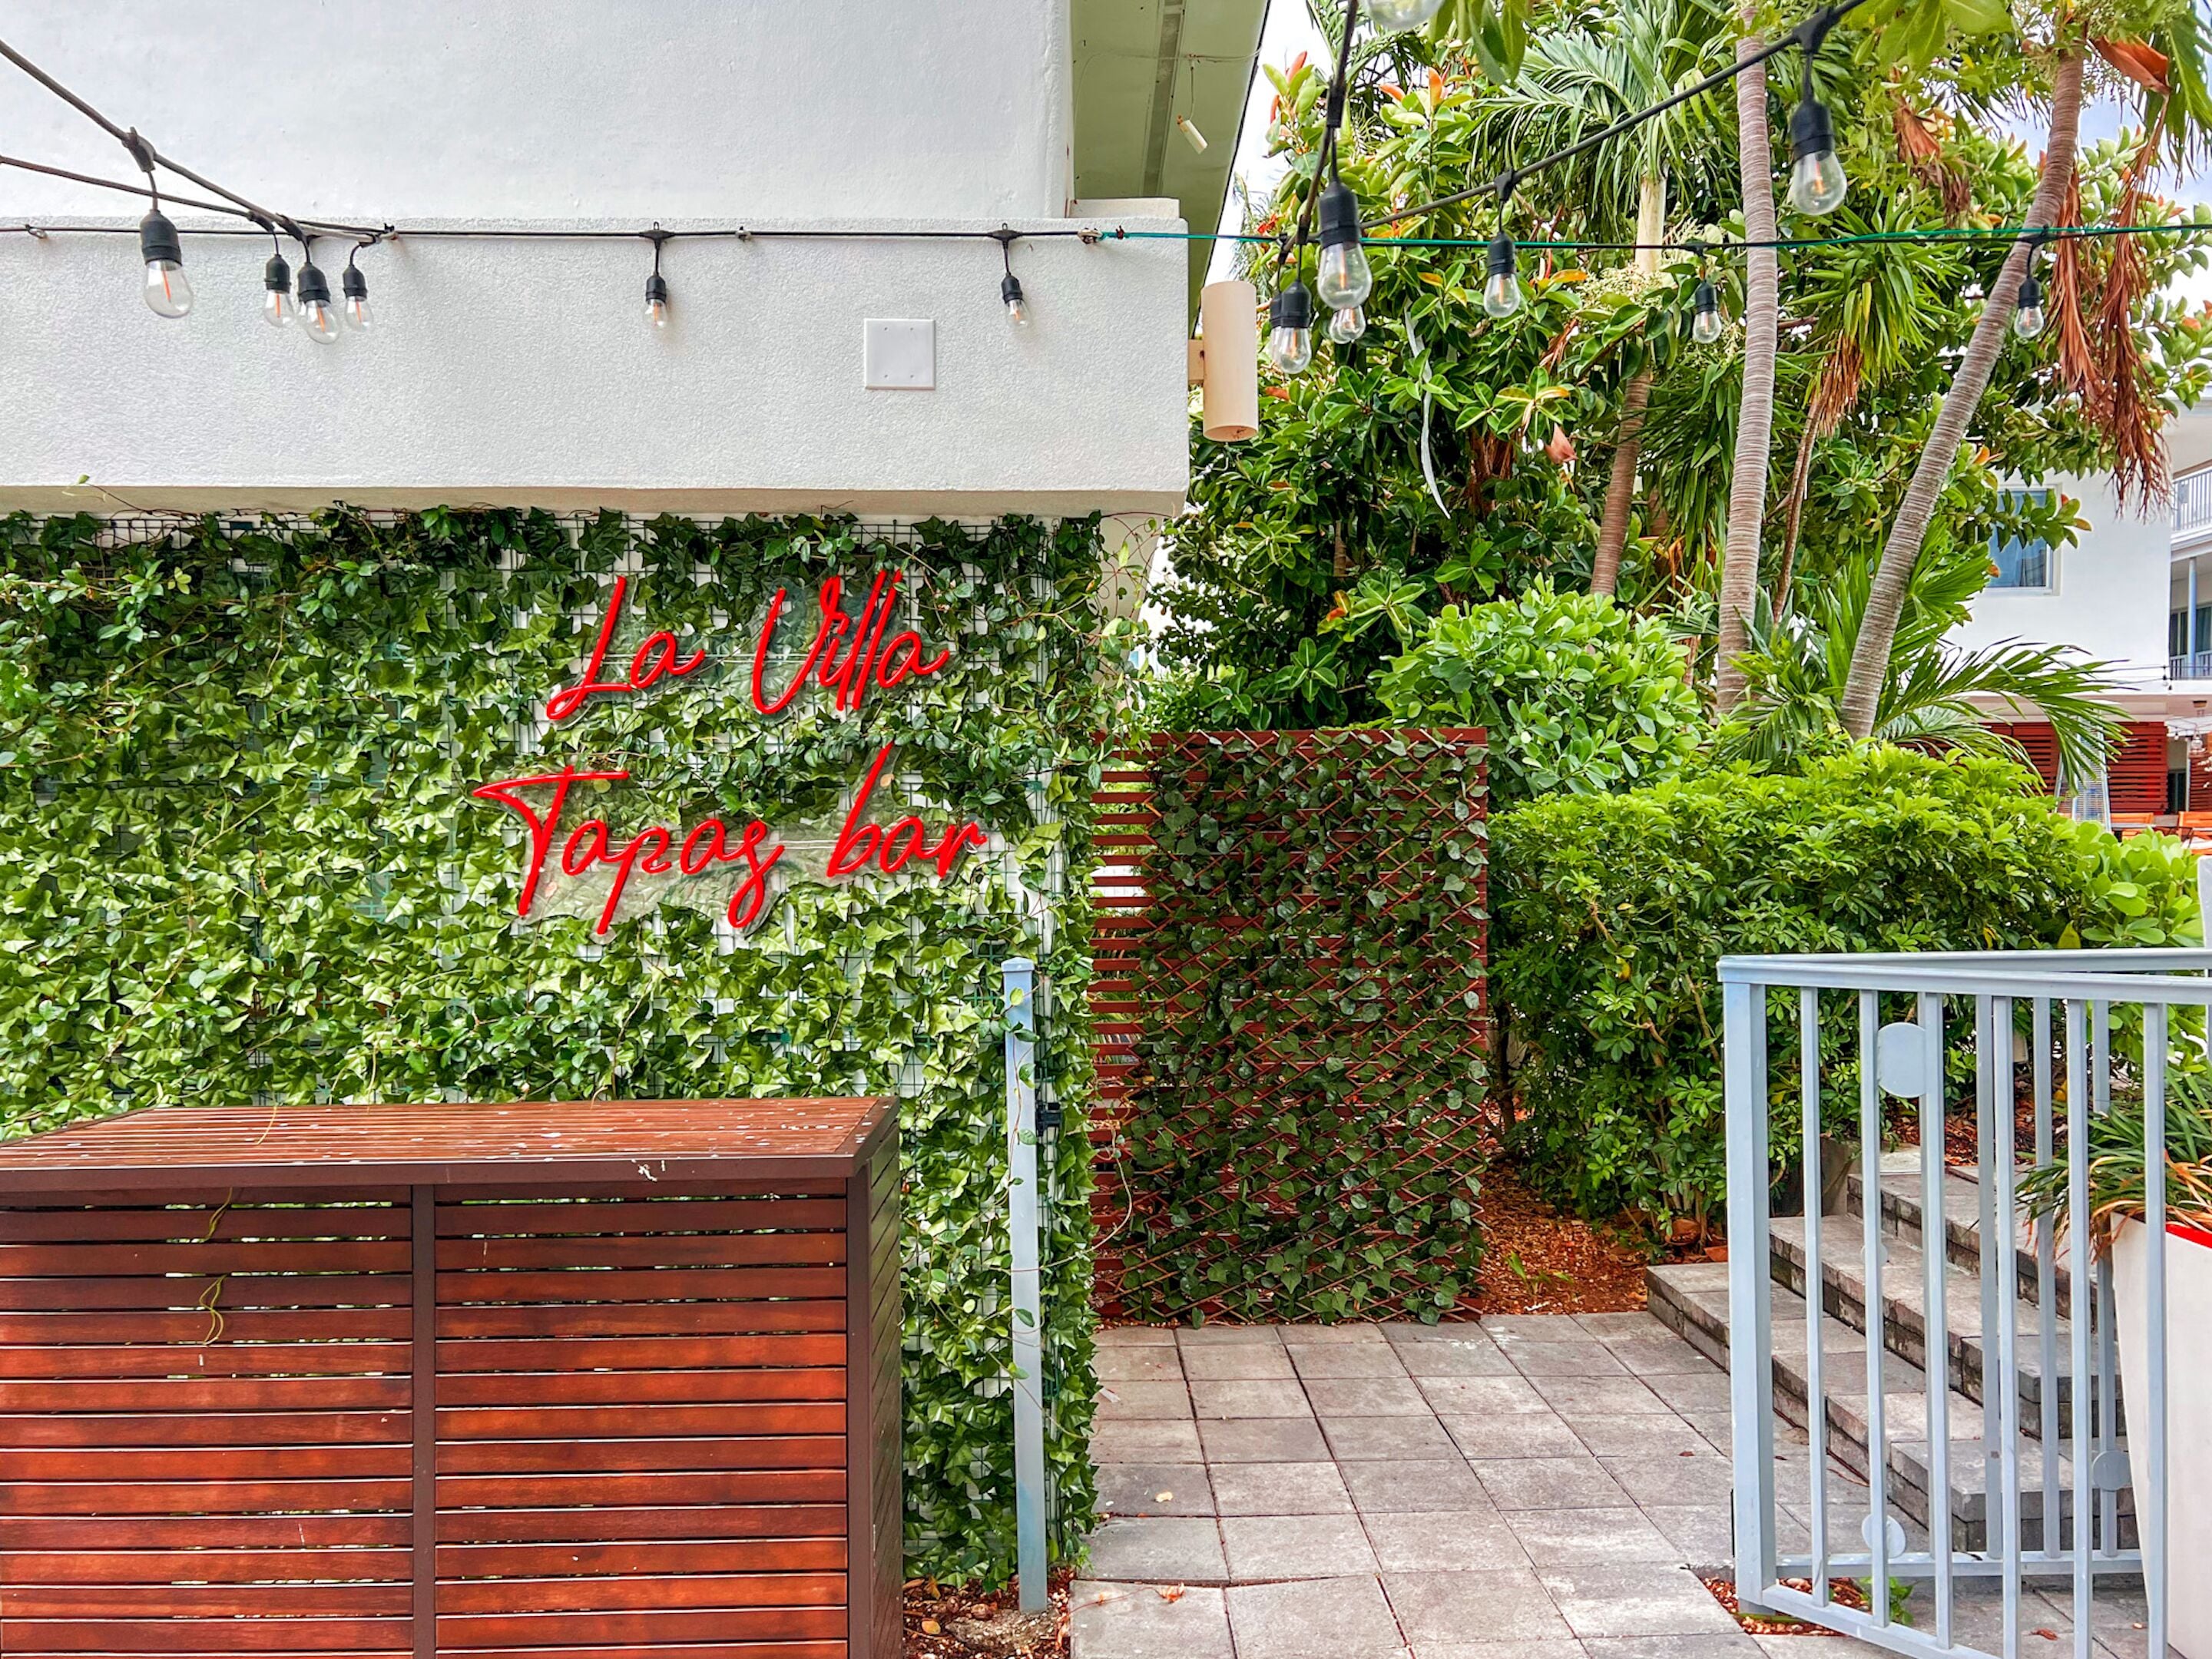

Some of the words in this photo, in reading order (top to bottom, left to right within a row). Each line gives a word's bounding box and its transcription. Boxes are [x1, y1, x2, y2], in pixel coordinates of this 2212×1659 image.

[545, 575, 706, 721] La
[751, 568, 951, 716] Villa
[471, 763, 786, 935] Tapas
[825, 740, 989, 879] bar
